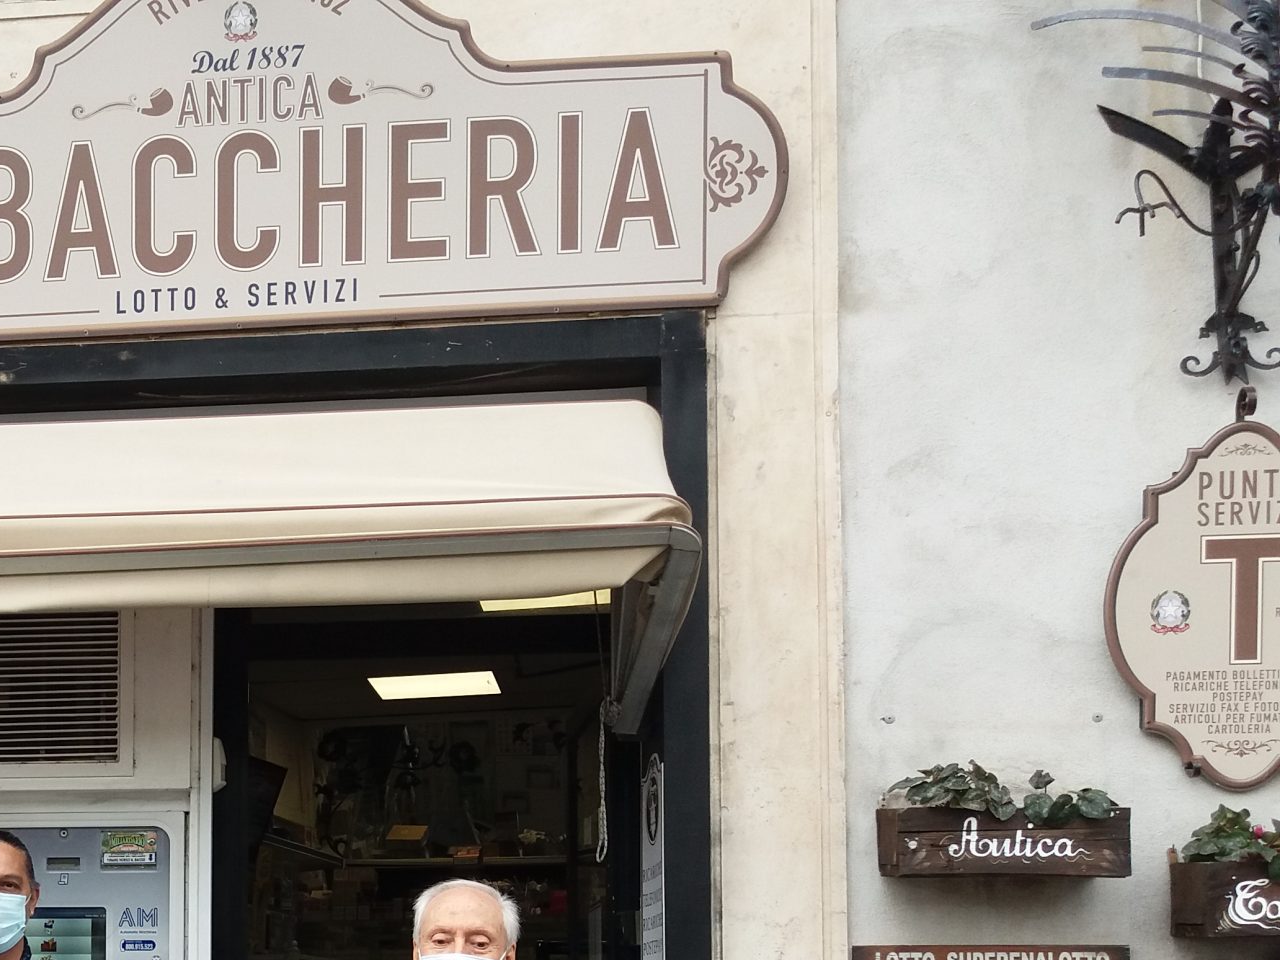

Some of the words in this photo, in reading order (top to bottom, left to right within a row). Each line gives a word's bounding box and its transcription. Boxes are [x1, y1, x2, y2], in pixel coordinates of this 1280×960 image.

[191, 50, 240, 74] Dal
[247, 44, 306, 71] 1887
[175, 71, 324, 128] ANTICA
[116, 286, 197, 315] LOTTO
[214, 286, 229, 309] &
[247, 277, 358, 307] SERVIZI
[1197, 500, 1280, 527] SERVI
[1166, 670, 1228, 681] PAGAMENTO
[1173, 681, 1229, 692] RICARICHE
[1212, 691, 1264, 702] POSTEPAY
[1168, 703, 1216, 714] SERVIZIO
[1221, 702, 1239, 713] FAX
[1244, 702, 1250, 712] E
[1173, 713, 1220, 724] ARTICOLI
[1225, 713, 1245, 723] PER
[1207, 723, 1271, 734] CARTOLERIA
[948, 816, 1088, 859] Antica
[119, 907, 158, 927] AM
